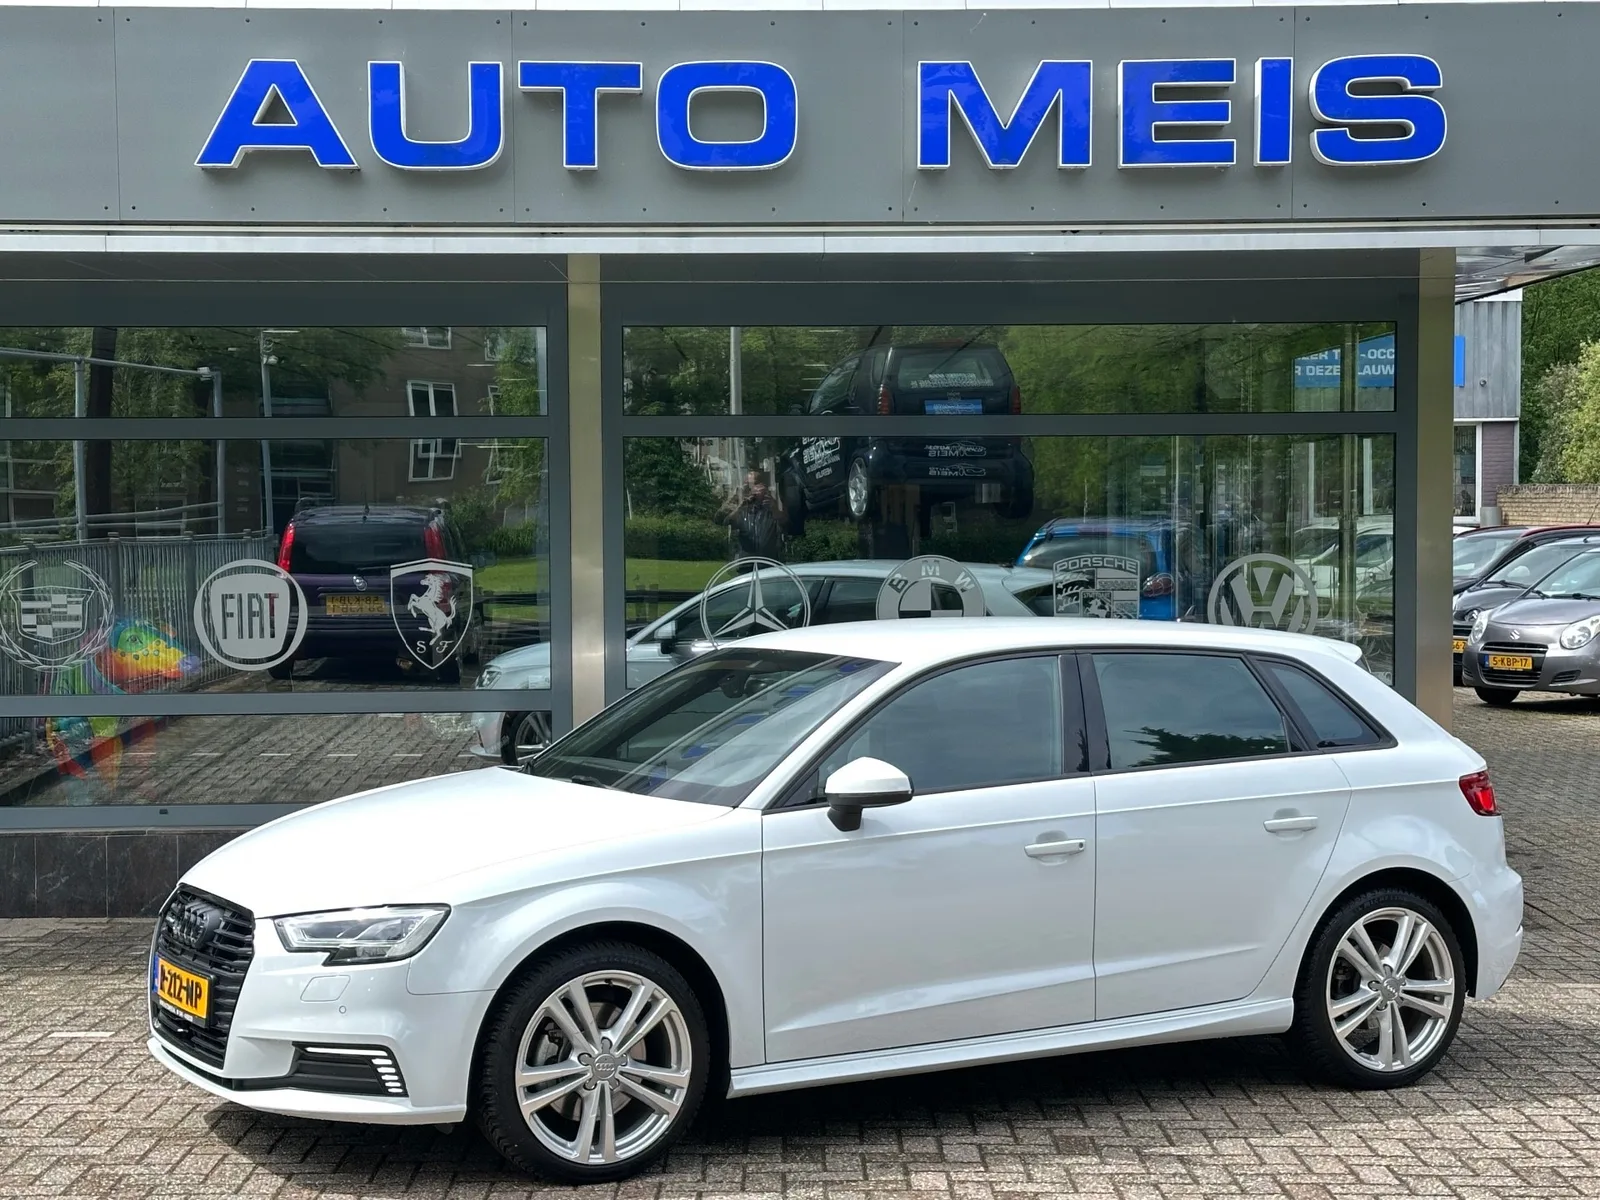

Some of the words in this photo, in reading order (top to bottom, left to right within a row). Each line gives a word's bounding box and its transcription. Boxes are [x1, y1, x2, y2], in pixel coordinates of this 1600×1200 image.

[194, 58, 798, 171] AUTO
[916, 53, 1447, 170] MEIS
[1305, 365, 1341, 376] DEZE
[1056, 557, 1138, 574] PORSCHE
[221, 592, 280, 640] FIAT
[416, 640, 427, 654] S
[1492, 656, 1529, 668] 5-KBP-17
